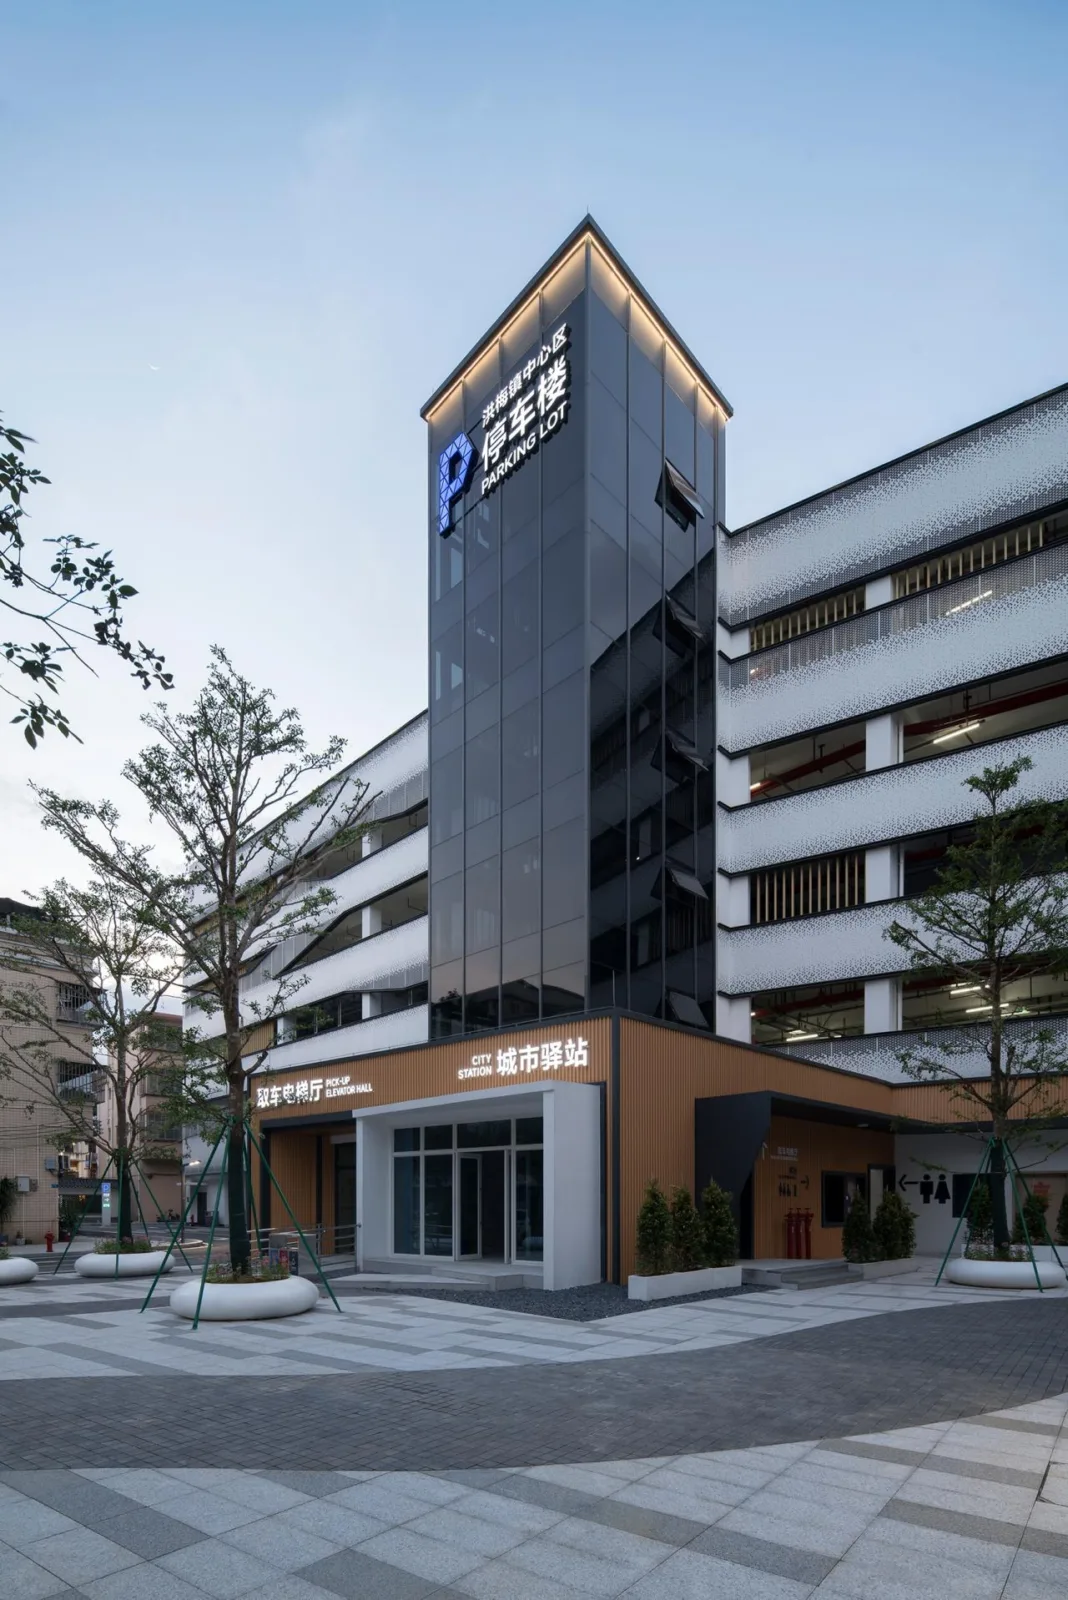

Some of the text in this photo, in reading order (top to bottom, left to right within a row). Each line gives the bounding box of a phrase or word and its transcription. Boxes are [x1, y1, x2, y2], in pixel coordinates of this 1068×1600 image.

[481, 355, 567, 472] 停车楼
[481, 400, 568, 495] PARKING LOT
[472, 1054, 492, 1066] CITY
[496, 1037, 589, 1076] 城市驿站
[326, 1076, 351, 1087] PICK-UP
[458, 1066, 492, 1080] STATION
[256, 1079, 324, 1108] 取车电梯厅
[326, 1083, 373, 1098] ELEVATOR HALL
